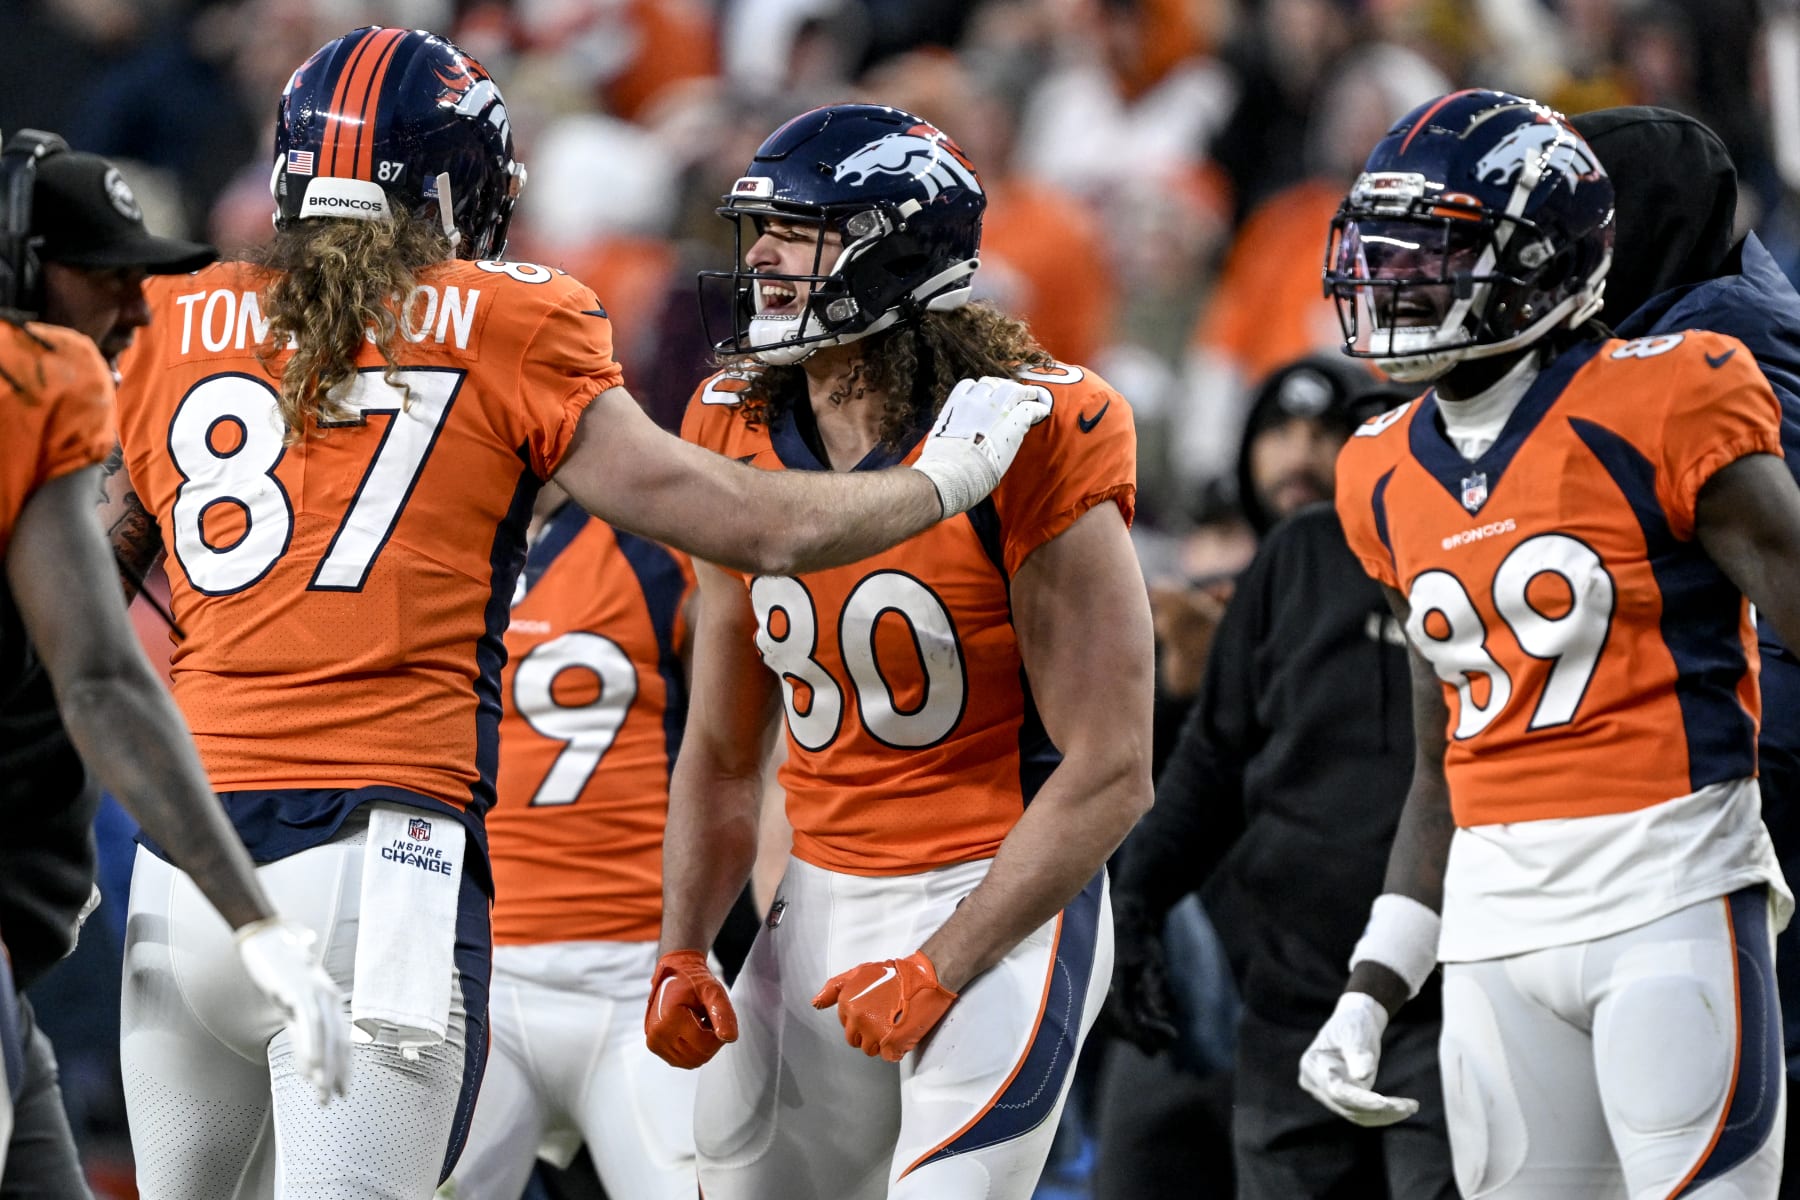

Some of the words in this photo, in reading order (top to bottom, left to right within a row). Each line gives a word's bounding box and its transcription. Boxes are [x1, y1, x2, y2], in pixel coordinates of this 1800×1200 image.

[377, 160, 404, 183] 87
[309, 196, 383, 212] BRONCOS
[474, 260, 569, 285] 8
[176, 284, 481, 355] TOMON
[167, 365, 468, 597] 87
[1441, 518, 1517, 550] BRONCOS
[1405, 531, 1618, 741] 89
[751, 568, 969, 753] 80
[410, 826, 430, 841] NFL
[381, 846, 454, 876] CHANGE
[392, 839, 443, 859] INSPIRE
